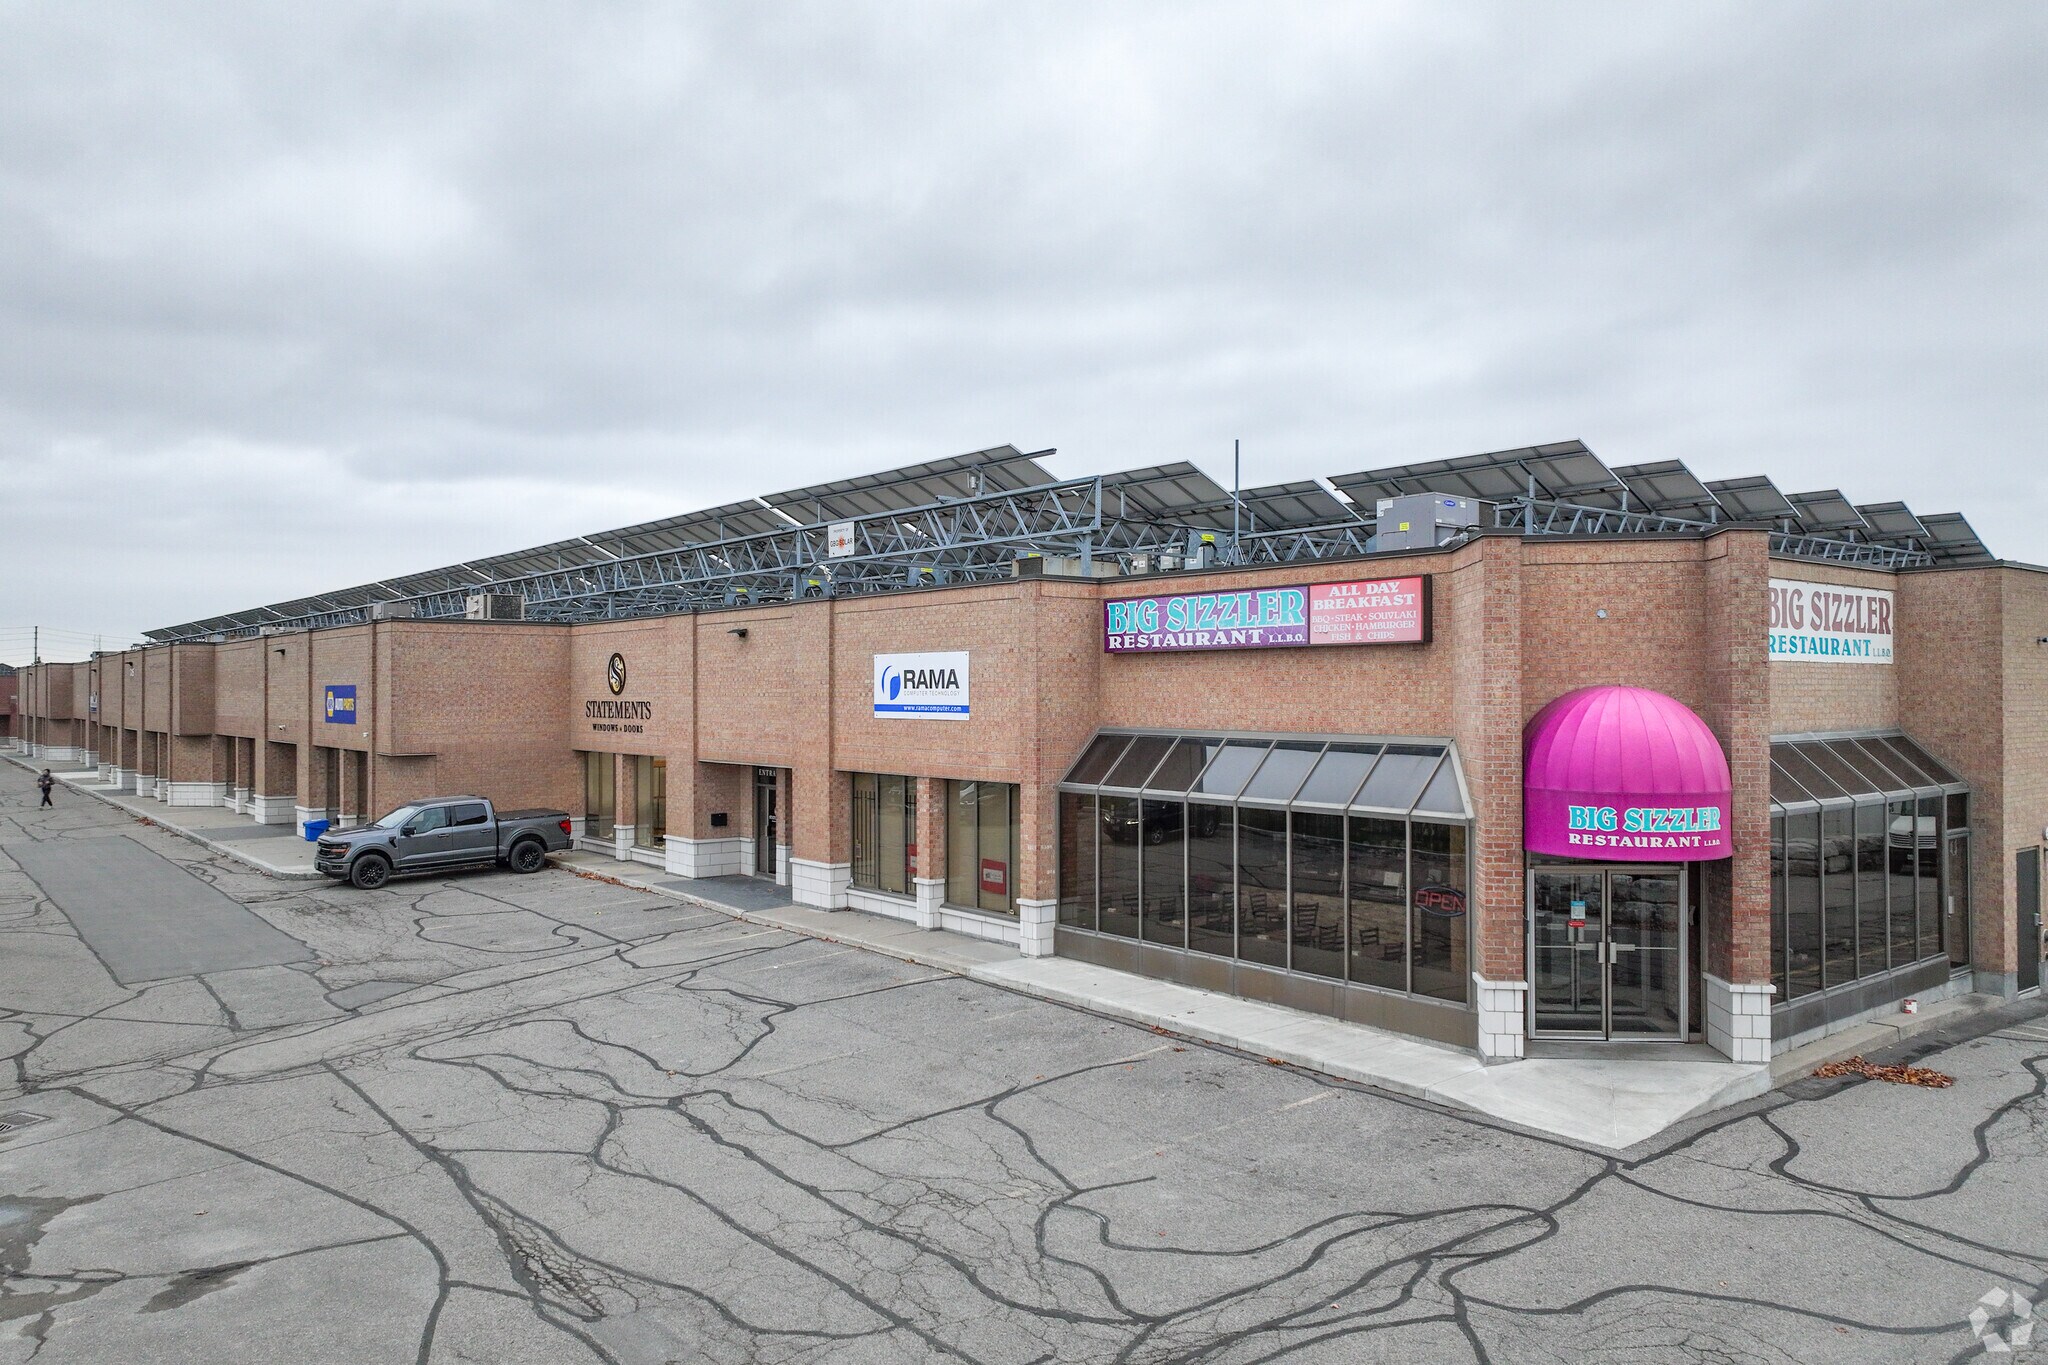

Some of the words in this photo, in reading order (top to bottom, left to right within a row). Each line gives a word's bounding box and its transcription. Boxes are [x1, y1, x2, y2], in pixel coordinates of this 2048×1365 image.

[1329, 585, 1360, 597] ALL
[1366, 582, 1400, 595] DAY
[1108, 599, 1159, 634] BIG
[1165, 590, 1305, 632] SIZZLER
[1313, 594, 1415, 610] BREAKFAST
[1768, 587, 1804, 630] BIG
[1810, 591, 1891, 635] SIZZLER
[1312, 615, 1330, 623] BBQ
[1335, 613, 1364, 621] STEAK
[1369, 610, 1417, 620] SOUVLAKI
[1313, 623, 1351, 633] CHICKEN
[1356, 620, 1415, 631] HAMBURGER
[1108, 629, 1263, 649] RESTAURANT
[1269, 634, 1306, 643] L.L.B.O.
[1331, 633, 1351, 641] FISH
[1356, 632, 1362, 640] &
[1367, 631, 1395, 640] CHIPS
[1768, 635, 1871, 657] RESTAURANT
[903, 669, 960, 689] RAMA
[586, 700, 652, 720] STATEMENTS
[593, 723, 618, 732] WINDOWS
[624, 725, 643, 734] DOORS
[1568, 805, 1618, 831] BIG
[1623, 807, 1721, 833] SIZZLER
[1569, 833, 1701, 848] RESTAURANT
[1415, 891, 1466, 912] OPEN
